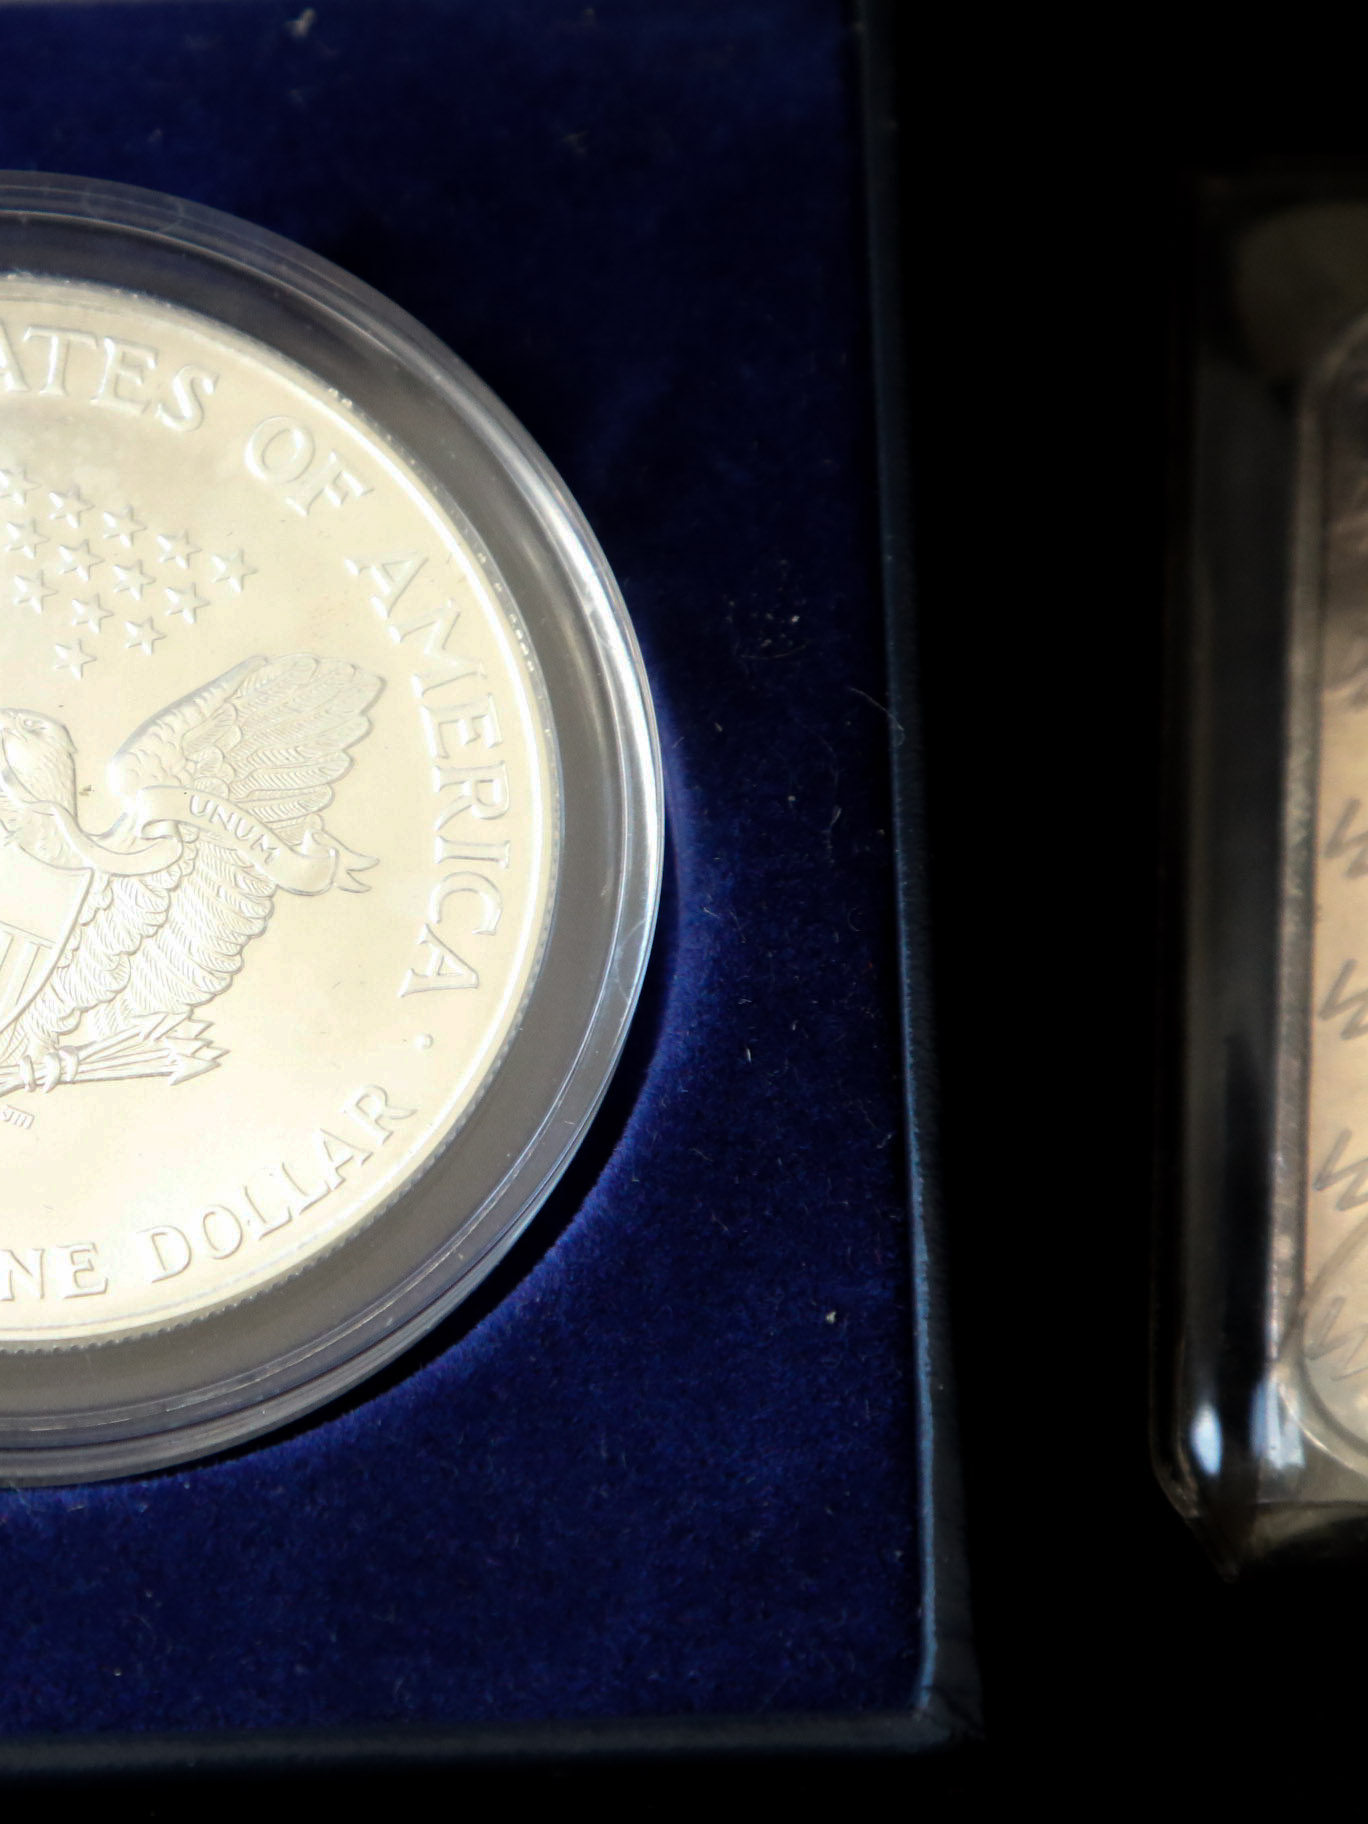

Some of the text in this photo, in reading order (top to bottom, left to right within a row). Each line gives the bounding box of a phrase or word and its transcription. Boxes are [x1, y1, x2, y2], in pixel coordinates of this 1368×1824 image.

[243, 414, 374, 516] OF
[344, 550, 512, 998] AMERICA
[189, 794, 280, 865] UNUM
[137, 1083, 418, 1284] DOLLAR
